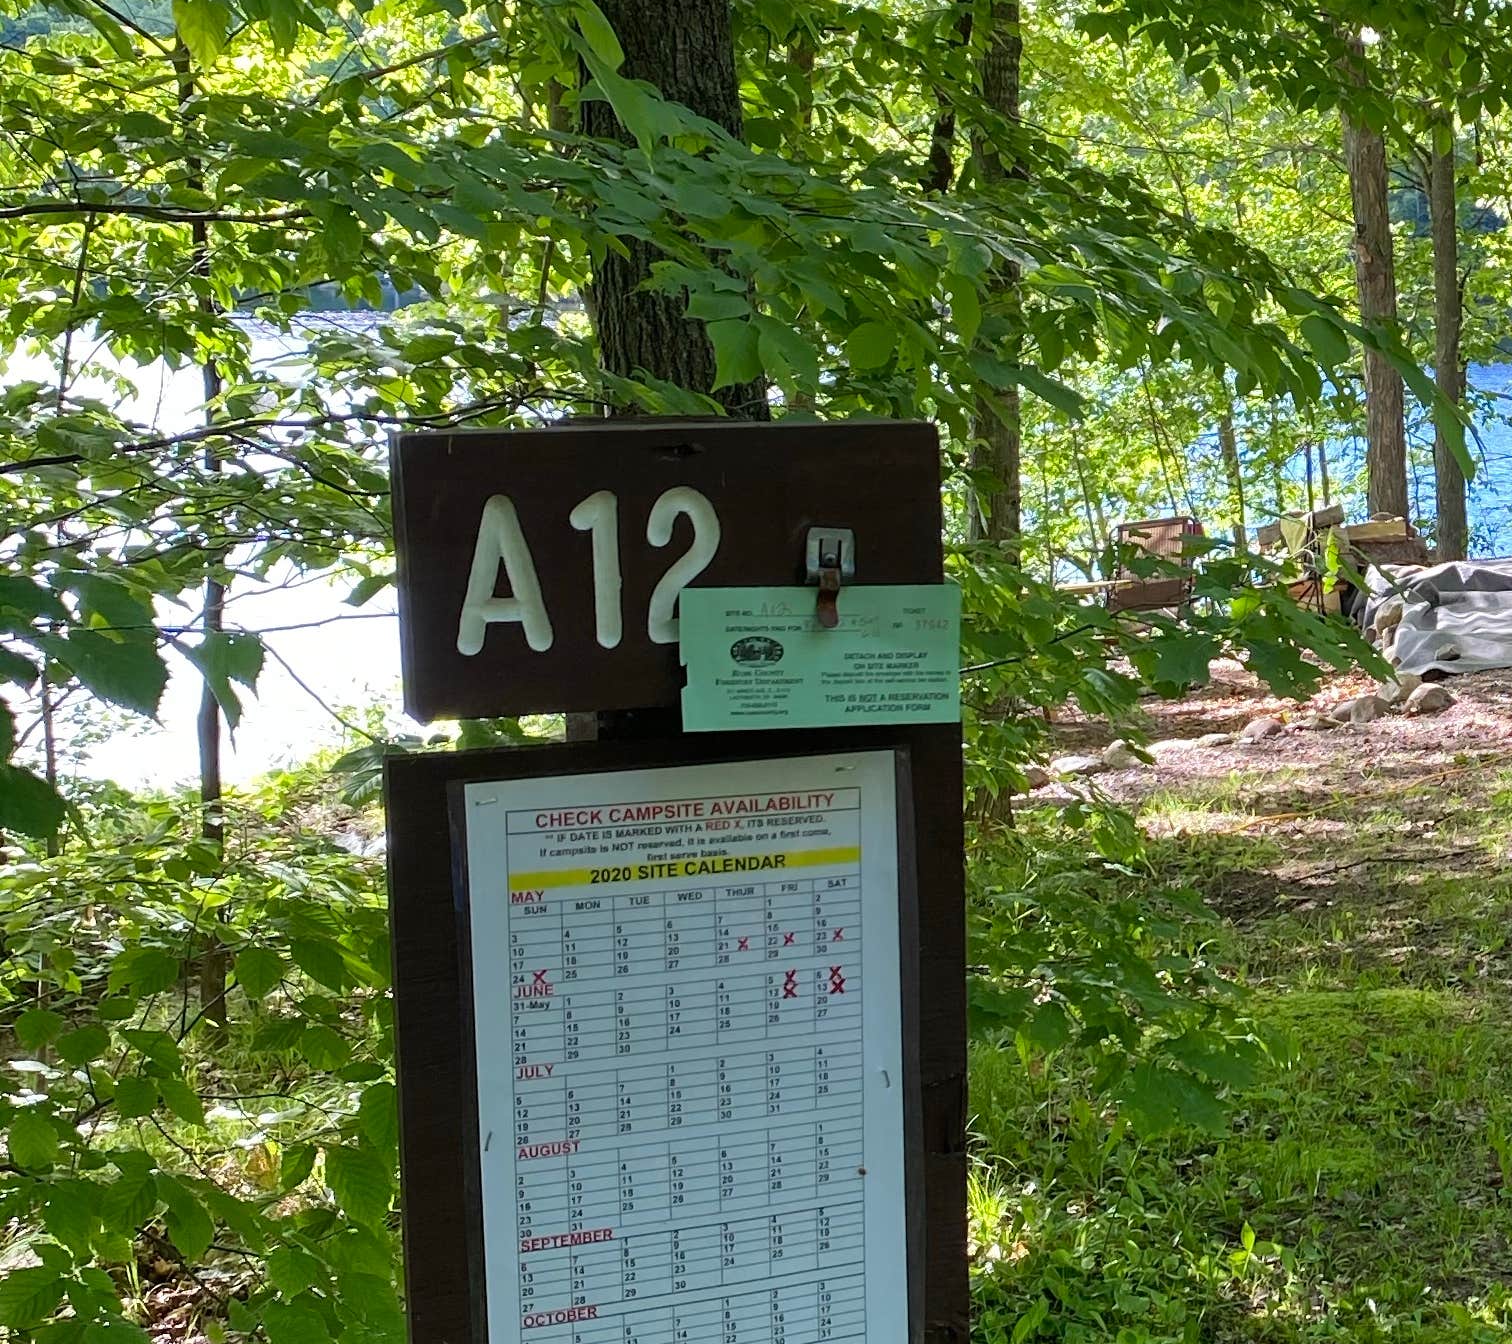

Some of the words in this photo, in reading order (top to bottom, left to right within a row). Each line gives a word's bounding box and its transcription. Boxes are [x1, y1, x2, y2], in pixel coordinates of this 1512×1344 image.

[456, 485, 721, 656] A12
[844, 652, 876, 660] DETACH
[877, 652, 895, 660] AND
[867, 662, 884, 670] SITE
[886, 661, 920, 669] MARKER
[824, 694, 846, 702] THIS
[848, 694, 857, 702] IS
[858, 693, 877, 703] NOT
[880, 693, 887, 701] A
[888, 692, 949, 701] RESERVATION
[844, 704, 903, 712] APPLICATION
[905, 703, 931, 712] FORM
[535, 810, 603, 828] CHECK
[608, 803, 704, 823] CAMPSITE
[710, 793, 834, 816] AVAILABILITY
[557, 833, 567, 843] IF
[570, 831, 600, 842] DATE
[602, 830, 612, 840] IS
[615, 826, 662, 839] MARKED
[665, 823, 693, 835] WITH
[695, 823, 703, 833] A
[705, 820, 730, 831] RED
[747, 819, 763, 828] ITS
[549, 846, 597, 857] campsite
[600, 844, 609, 853] is
[612, 842, 634, 852] NOT
[697, 837, 706, 846] is
[709, 834, 753, 845] available
[755, 833, 769, 841] on
[780, 830, 800, 839] first
[647, 852, 667, 862] first
[670, 851, 698, 861] serve
[590, 867, 632, 884] 2020
[637, 862, 678, 880] SITE
[684, 854, 786, 876] CALENDAR
[511, 890, 545, 904] MAY
[524, 905, 547, 915] SUN
[575, 900, 601, 911] MON
[629, 896, 650, 906] TUE
[677, 891, 703, 902] WED
[725, 887, 755, 897] THUR
[781, 883, 798, 892] FRI
[827, 878, 847, 888] SAT
[513, 948, 524, 957] 10
[565, 943, 576, 951] 11
[617, 939, 628, 947] 12
[668, 934, 679, 942] 13
[513, 961, 524, 970] 17
[668, 947, 679, 955] 20
[719, 942, 729, 950] 21
[513, 976, 524, 984] 24
[565, 970, 577, 979] 25
[668, 960, 679, 969] 27
[512, 984, 554, 999] JUNE
[513, 1001, 551, 1011] 31-May
[515, 1029, 526, 1037] 14
[669, 1013, 680, 1021] 17
[515, 1043, 526, 1051] 21
[567, 1037, 579, 1046] 22
[619, 1032, 630, 1040] 23
[669, 1026, 680, 1034] 24
[720, 1020, 730, 1029] 25
[515, 1057, 527, 1065] 28
[619, 1045, 631, 1053] 30
[516, 1064, 553, 1080] JULY
[770, 1066, 780, 1074] 10
[517, 1109, 528, 1118] 12
[569, 1103, 580, 1112] 13
[620, 1097, 631, 1105] 14
[770, 1079, 780, 1087] 17
[569, 1117, 580, 1125] 20
[620, 1110, 631, 1119] 21
[671, 1104, 682, 1112] 22
[770, 1092, 780, 1100] 24
[818, 1086, 829, 1094] 25
[569, 1130, 580, 1139] 27
[518, 1140, 580, 1159] AUGUST
[571, 1183, 582, 1191] 10
[672, 1169, 683, 1177] 12
[722, 1162, 733, 1170] 13
[571, 1196, 582, 1205] 17
[722, 1175, 733, 1184] 20
[520, 1216, 531, 1224] 23
[571, 1209, 583, 1218] 24
[520, 1230, 532, 1238] 30
[571, 1223, 583, 1231] 31
[521, 1228, 613, 1252] SEPTEMBER
[522, 1288, 534, 1296] 20
[574, 1280, 585, 1289] 21
[625, 1273, 636, 1281] 22
[522, 1304, 534, 1313] 27
[574, 1296, 586, 1305] 28
[625, 1289, 636, 1297] 29
[675, 1281, 686, 1289] 30
[523, 1306, 597, 1327] OCTOBER
[821, 1318, 831, 1326] 24
